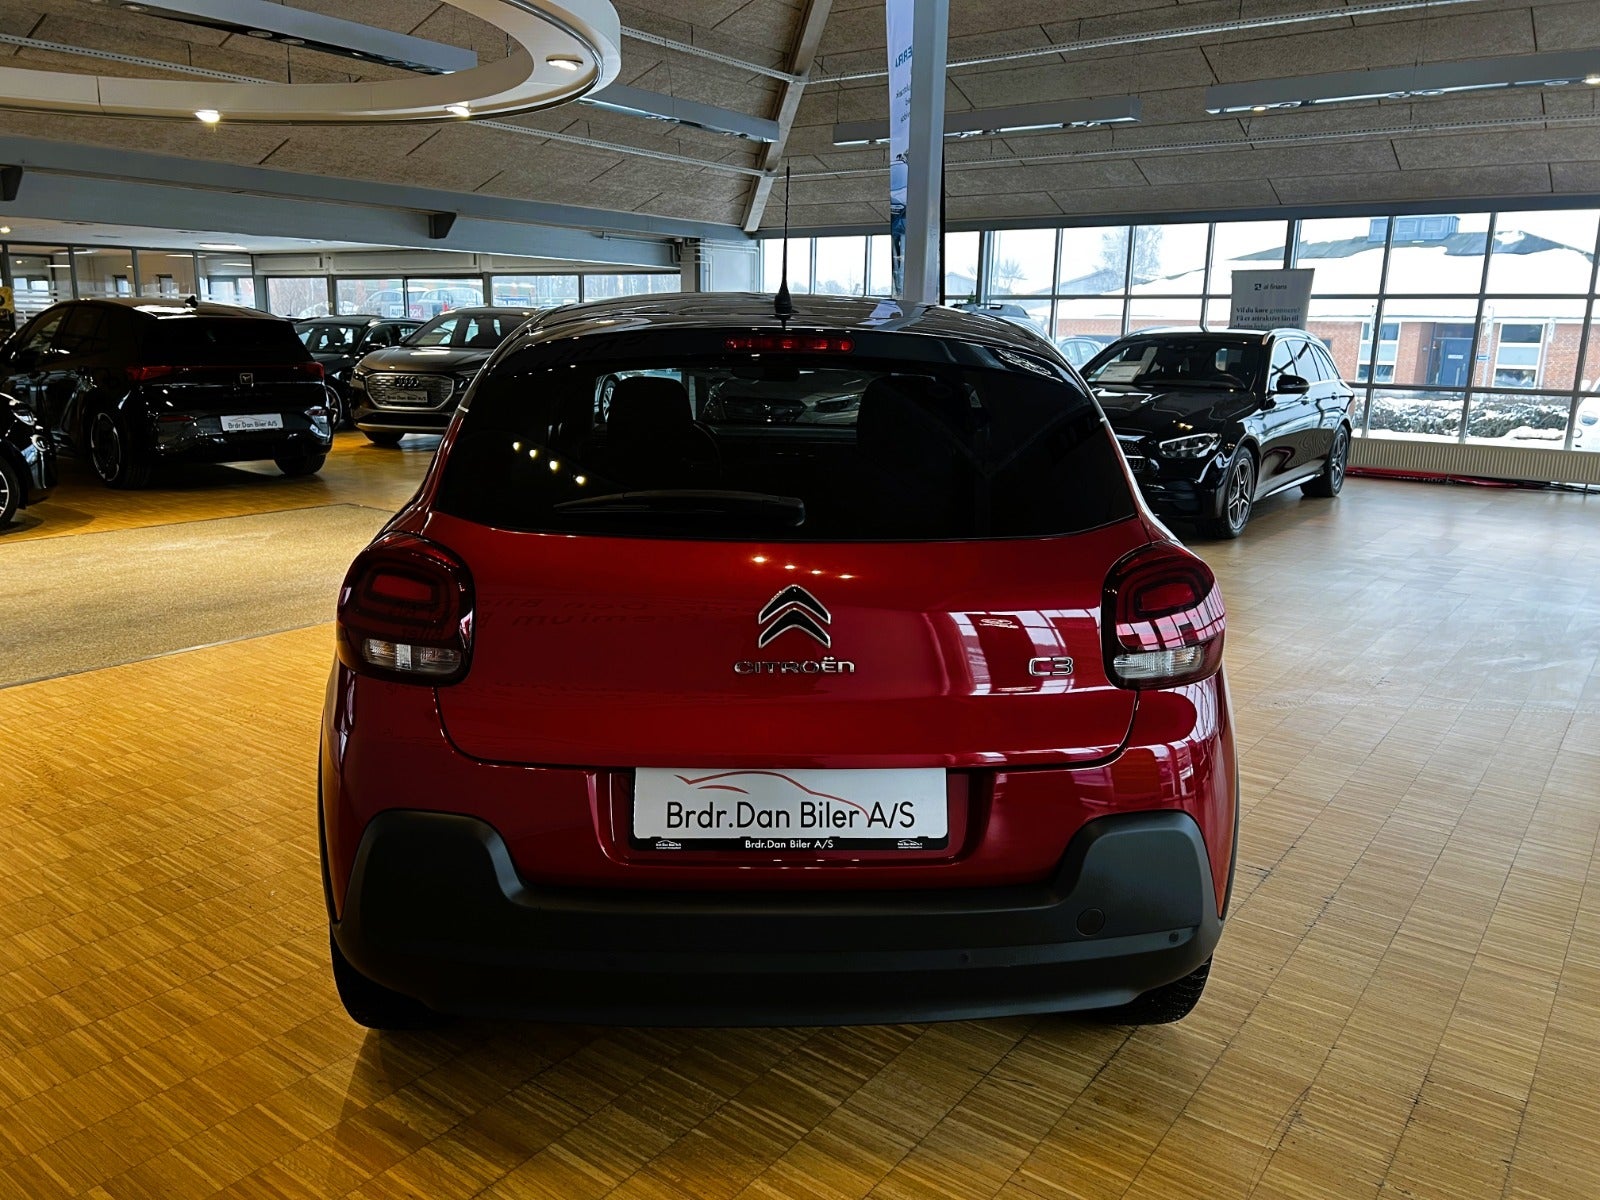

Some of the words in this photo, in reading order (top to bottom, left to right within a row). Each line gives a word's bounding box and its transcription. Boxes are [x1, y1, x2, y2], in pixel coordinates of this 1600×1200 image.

[1028, 657, 1074, 677] C3
[800, 801, 859, 829] Biler
[867, 801, 916, 829] A/S
[790, 840, 811, 849] Biler
[814, 840, 834, 849] A/S
